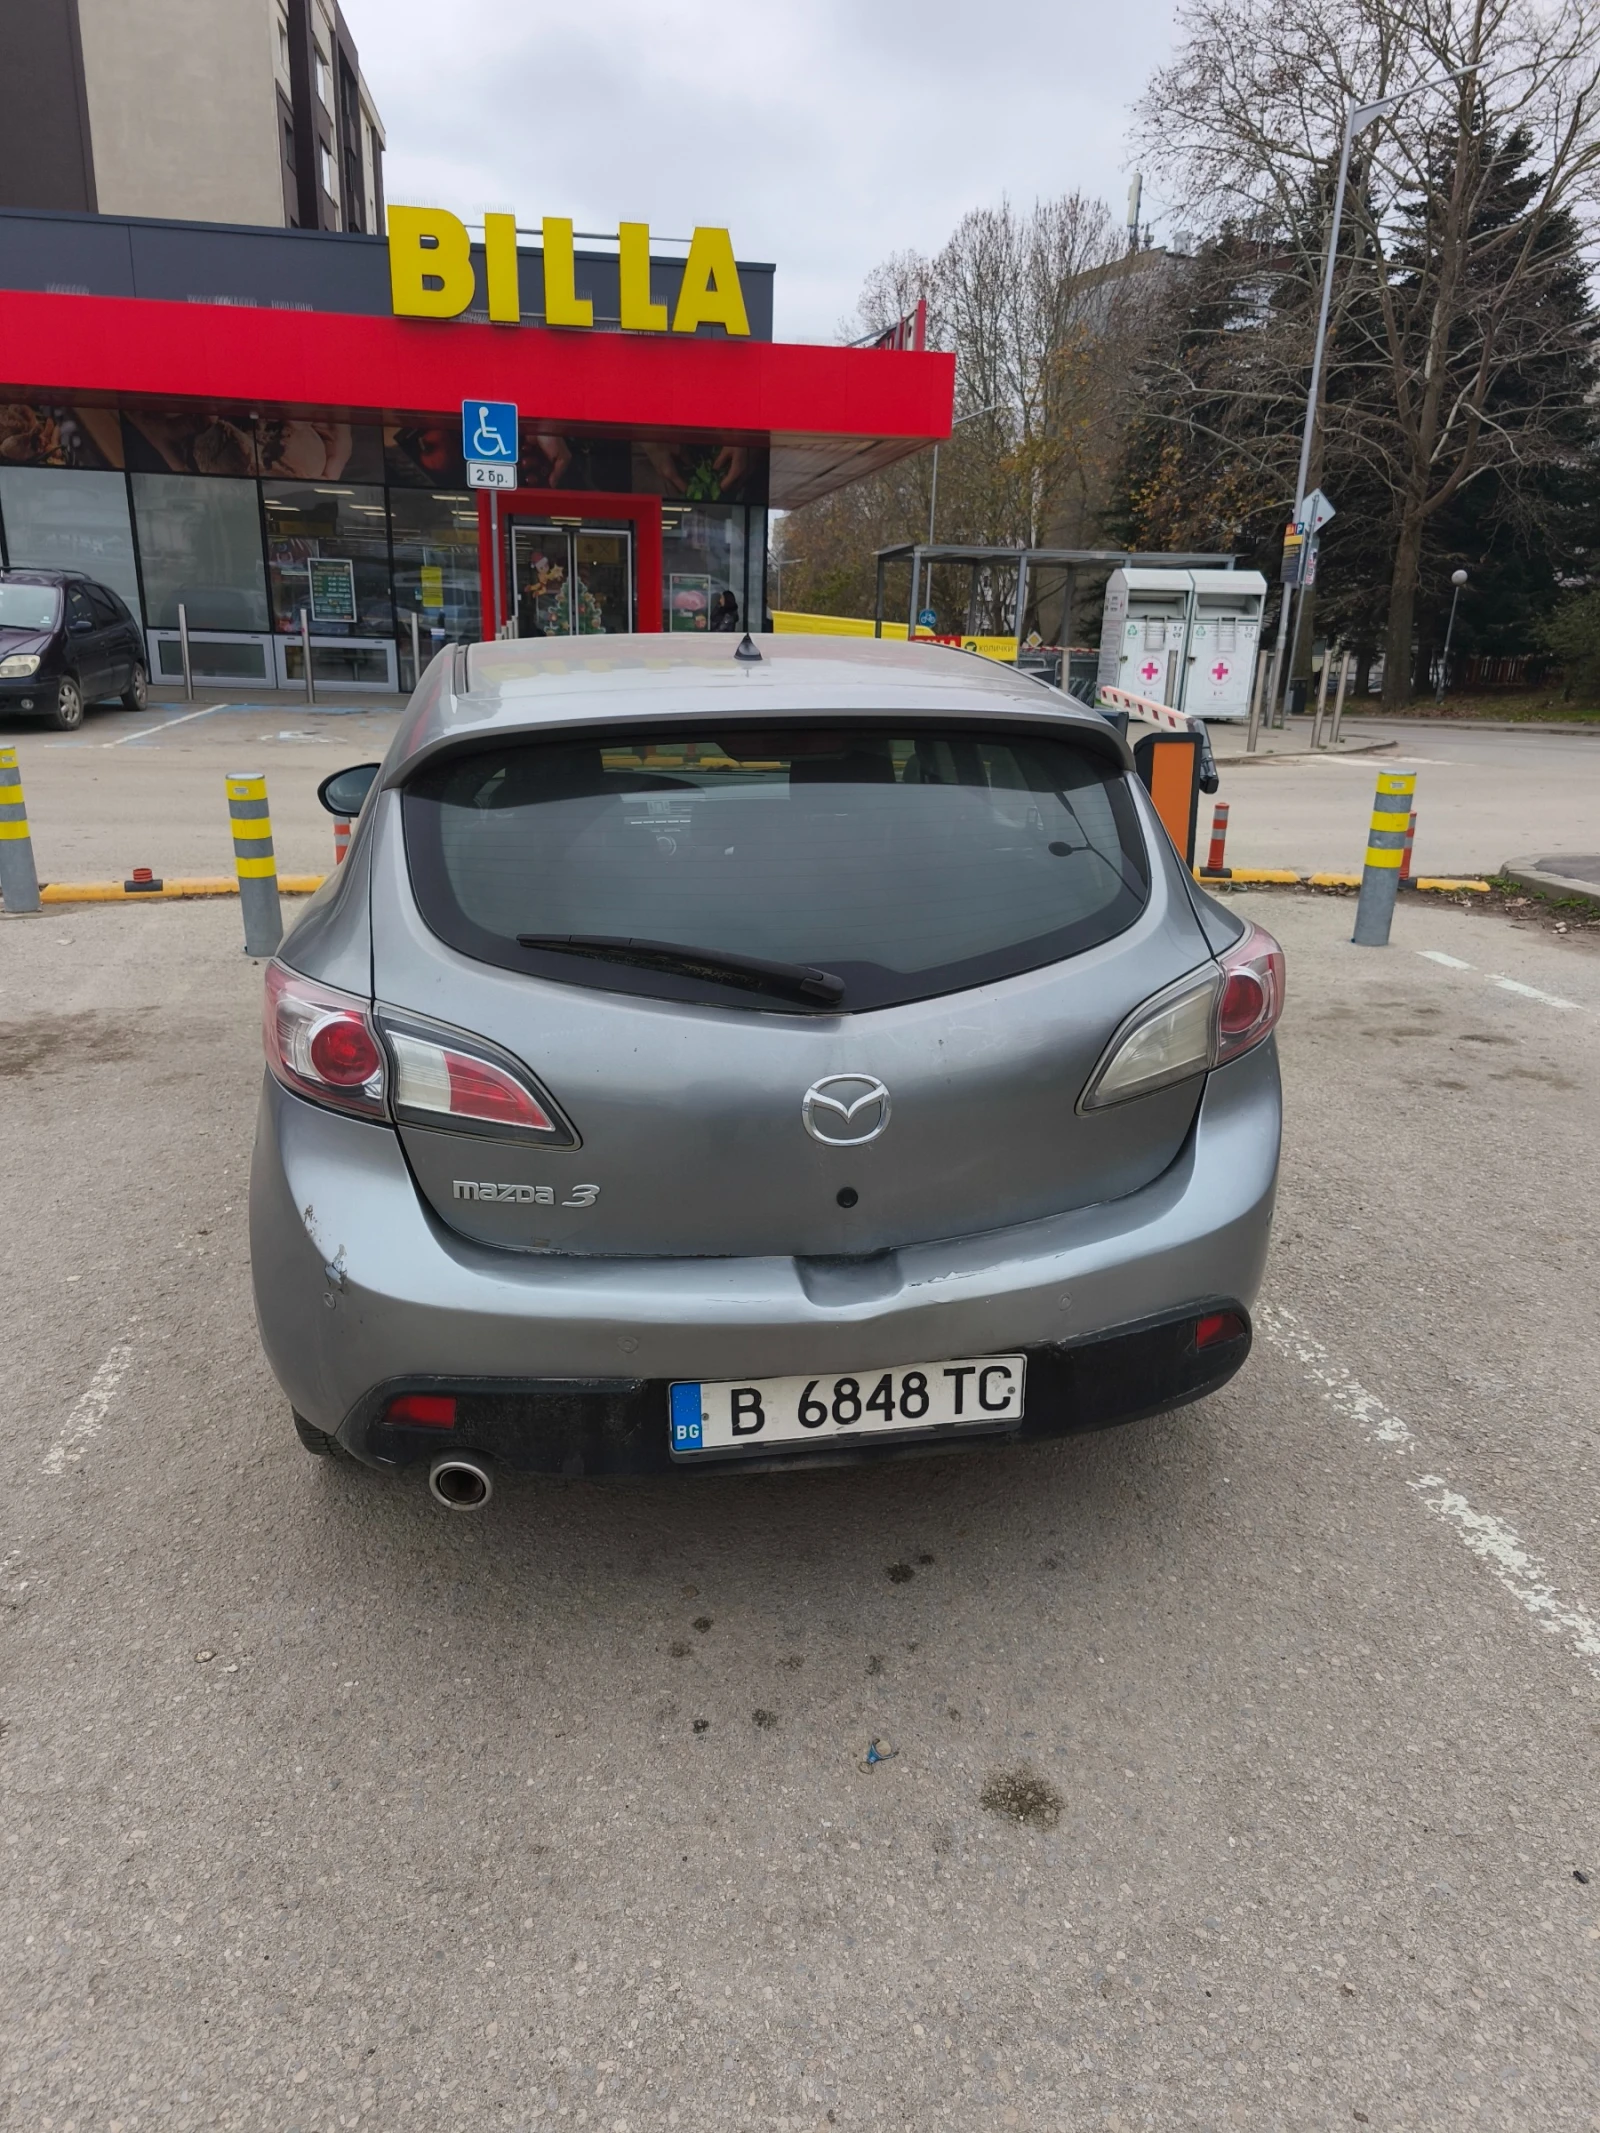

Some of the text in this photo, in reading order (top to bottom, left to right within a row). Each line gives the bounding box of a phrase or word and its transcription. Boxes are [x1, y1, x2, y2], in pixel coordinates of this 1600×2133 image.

[387, 204, 751, 336] BILLA
[476, 469, 508, 486] 2 бр.
[1296, 523, 1304, 534] P
[452, 1179, 601, 1208] mazda 3
[730, 1365, 1013, 1436] B 6848 TC
[676, 1424, 700, 1440] BG
